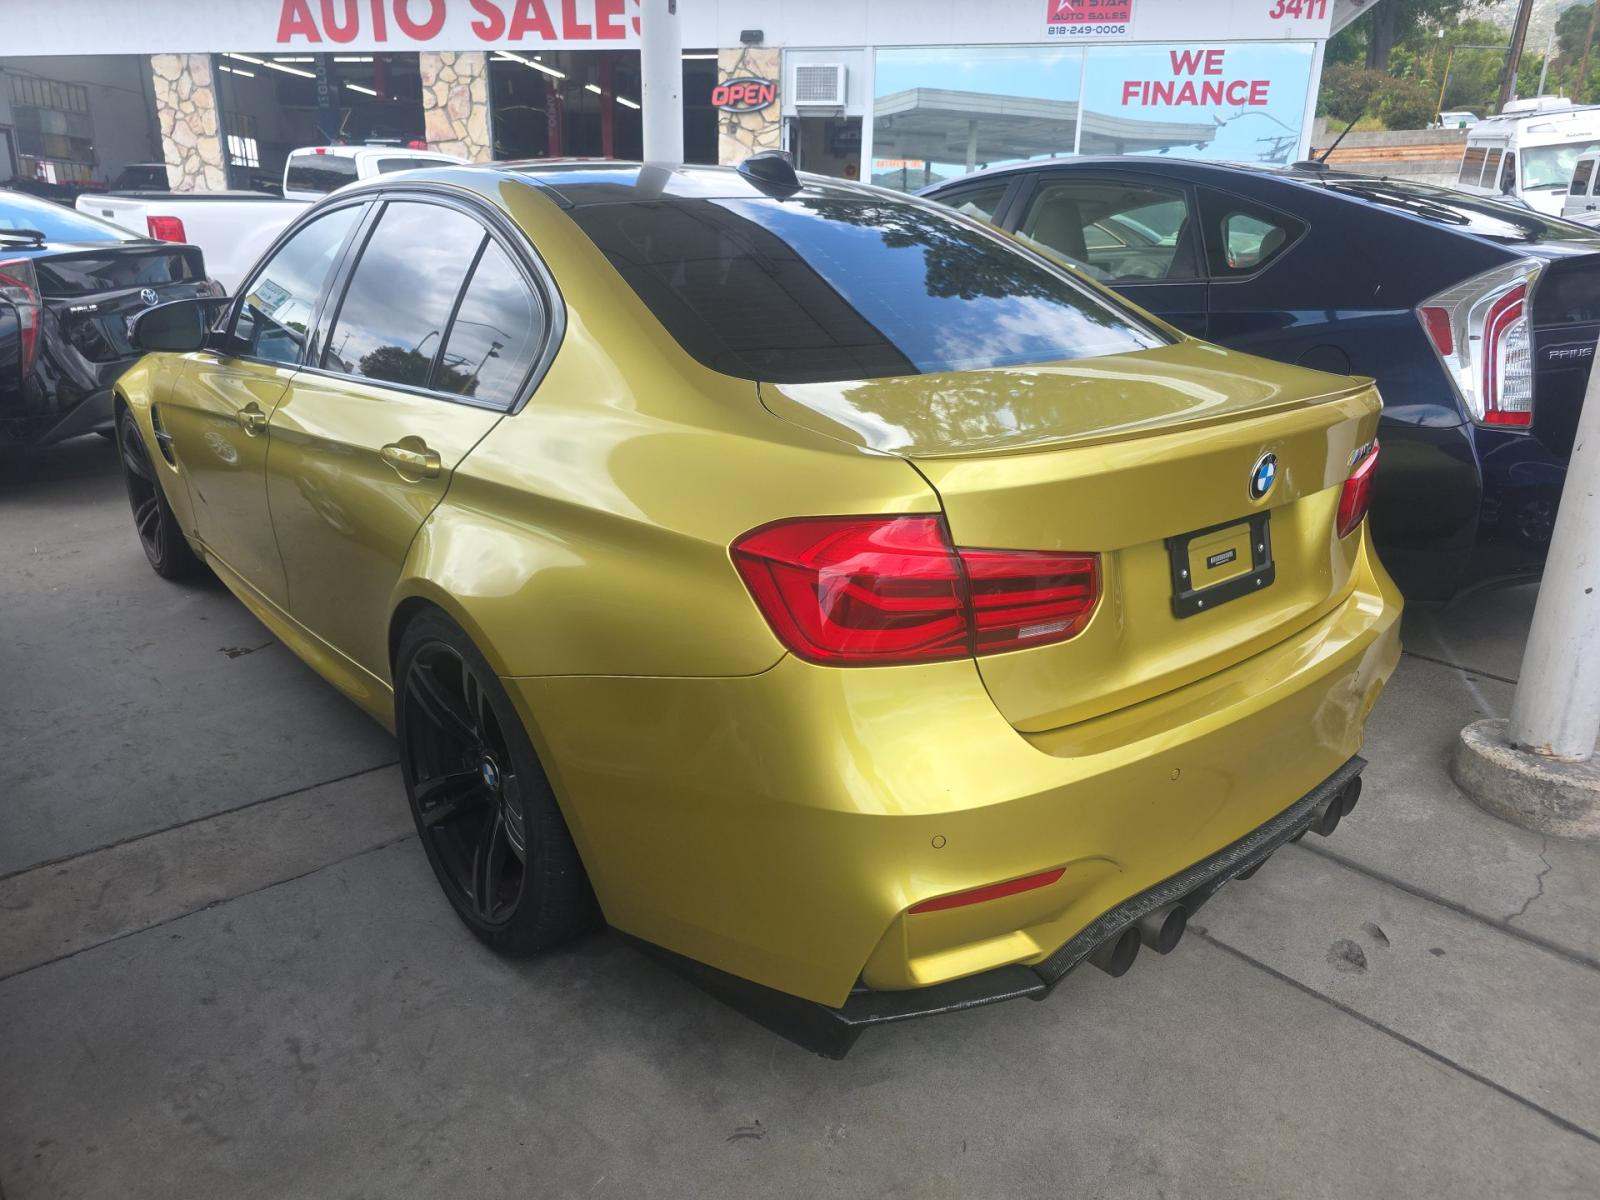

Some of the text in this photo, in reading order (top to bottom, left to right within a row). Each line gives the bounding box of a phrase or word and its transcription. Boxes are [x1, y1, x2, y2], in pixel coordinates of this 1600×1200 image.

[277, 0, 641, 43] AUTO SALE
[1052, 12, 1127, 20] AUTO SALES
[1269, 0, 1327, 20] 3411
[1048, 26, 1125, 35] 818-249-0006
[1170, 49, 1225, 76] WE
[711, 82, 777, 106] OPEN
[1121, 80, 1270, 106] FINANCE
